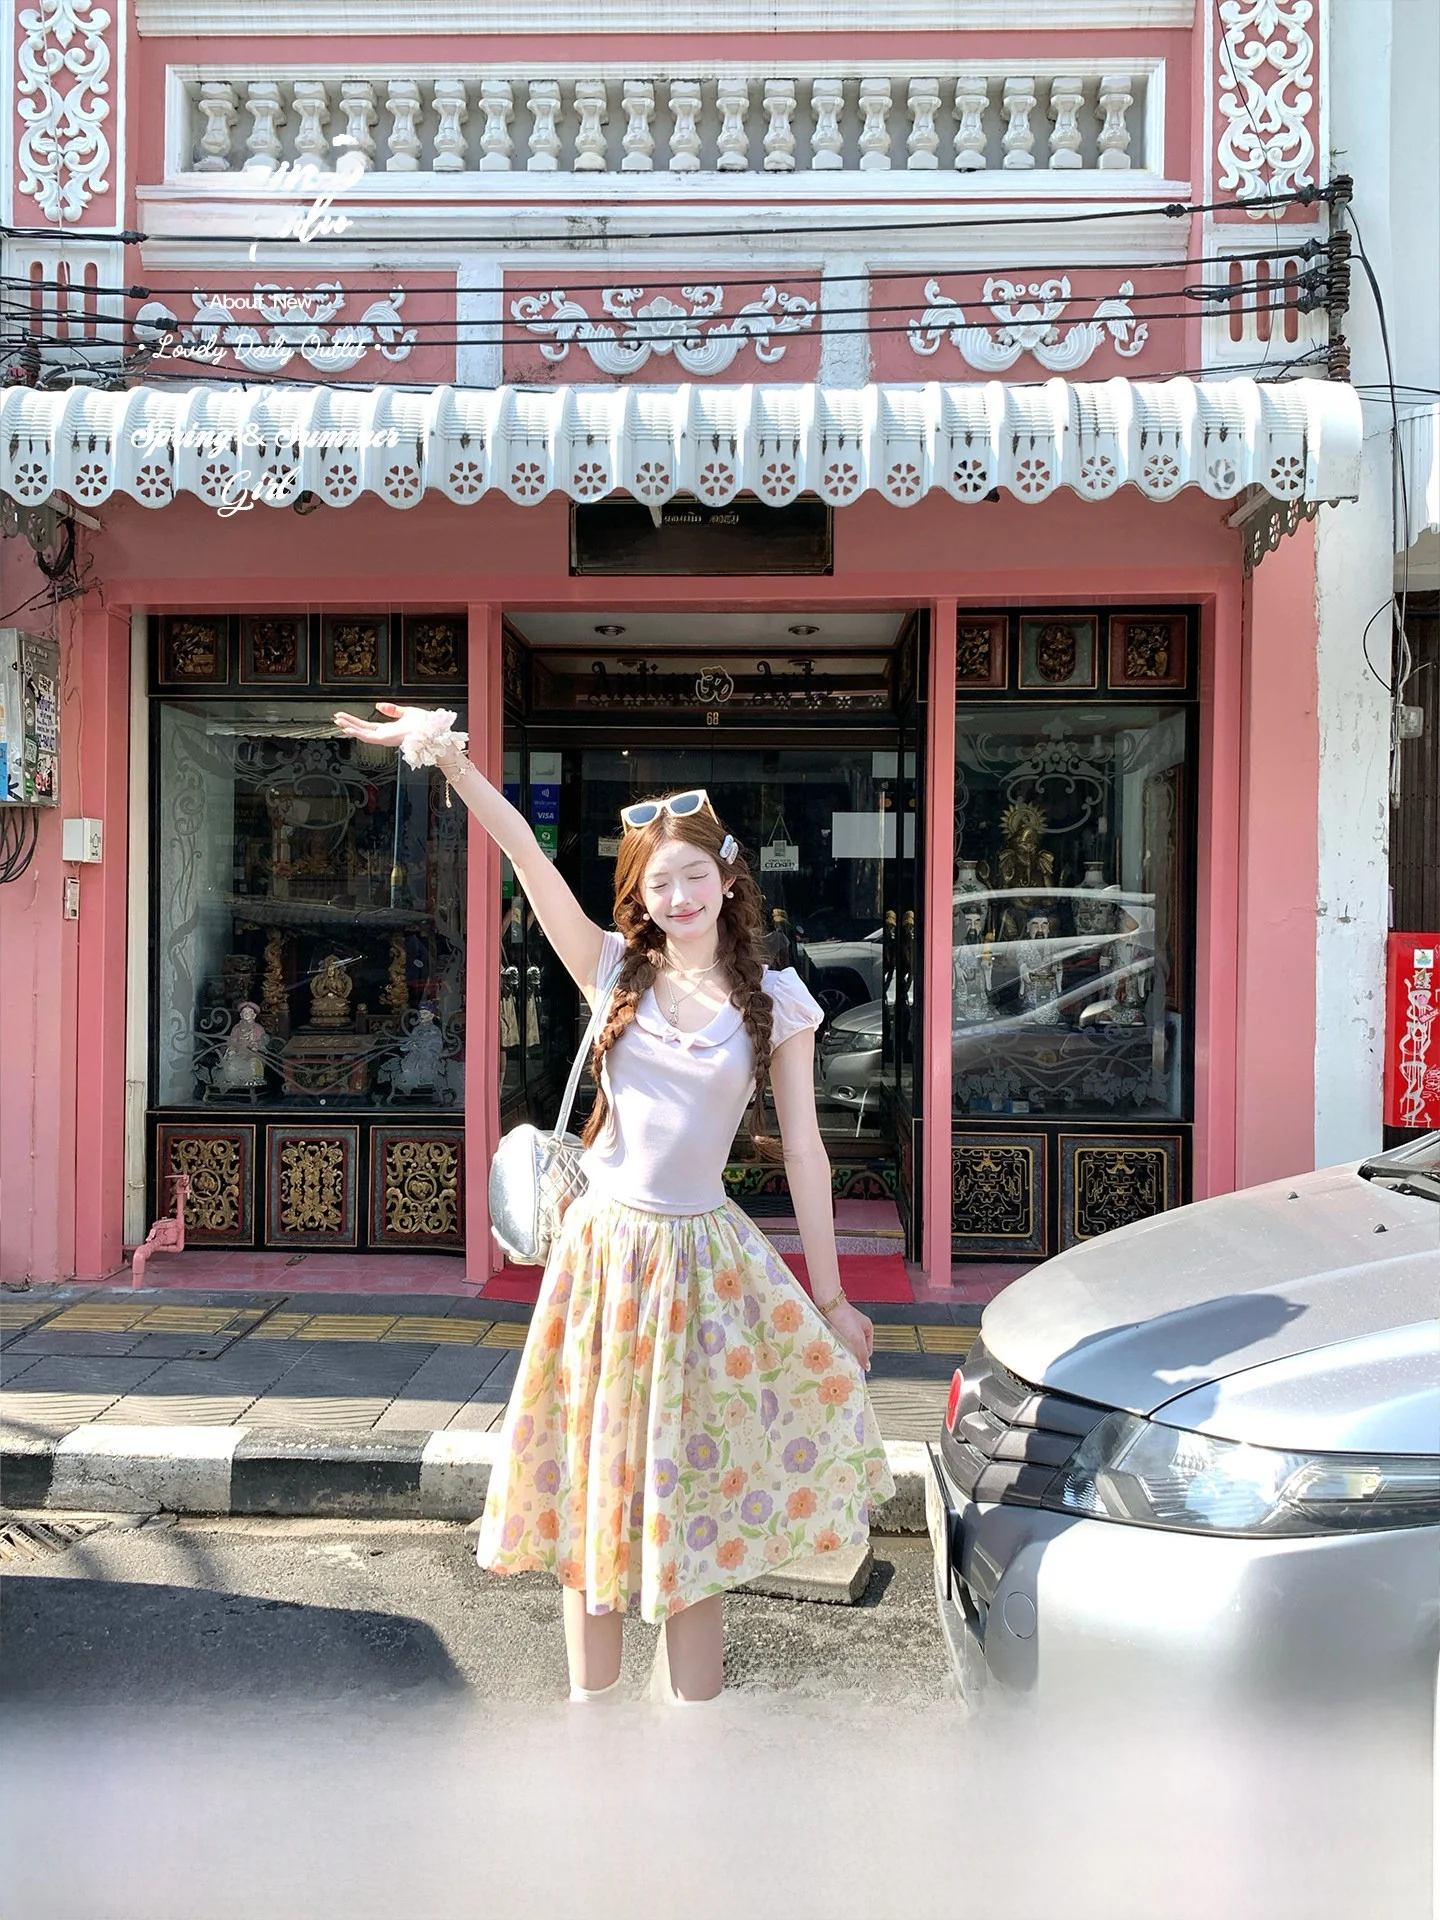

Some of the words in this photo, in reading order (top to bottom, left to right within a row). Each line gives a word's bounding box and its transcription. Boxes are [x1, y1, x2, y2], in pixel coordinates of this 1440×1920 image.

[706, 711, 719, 726] 68
[536, 811, 555, 820] VISA
[764, 861, 795, 869] CLOSED
